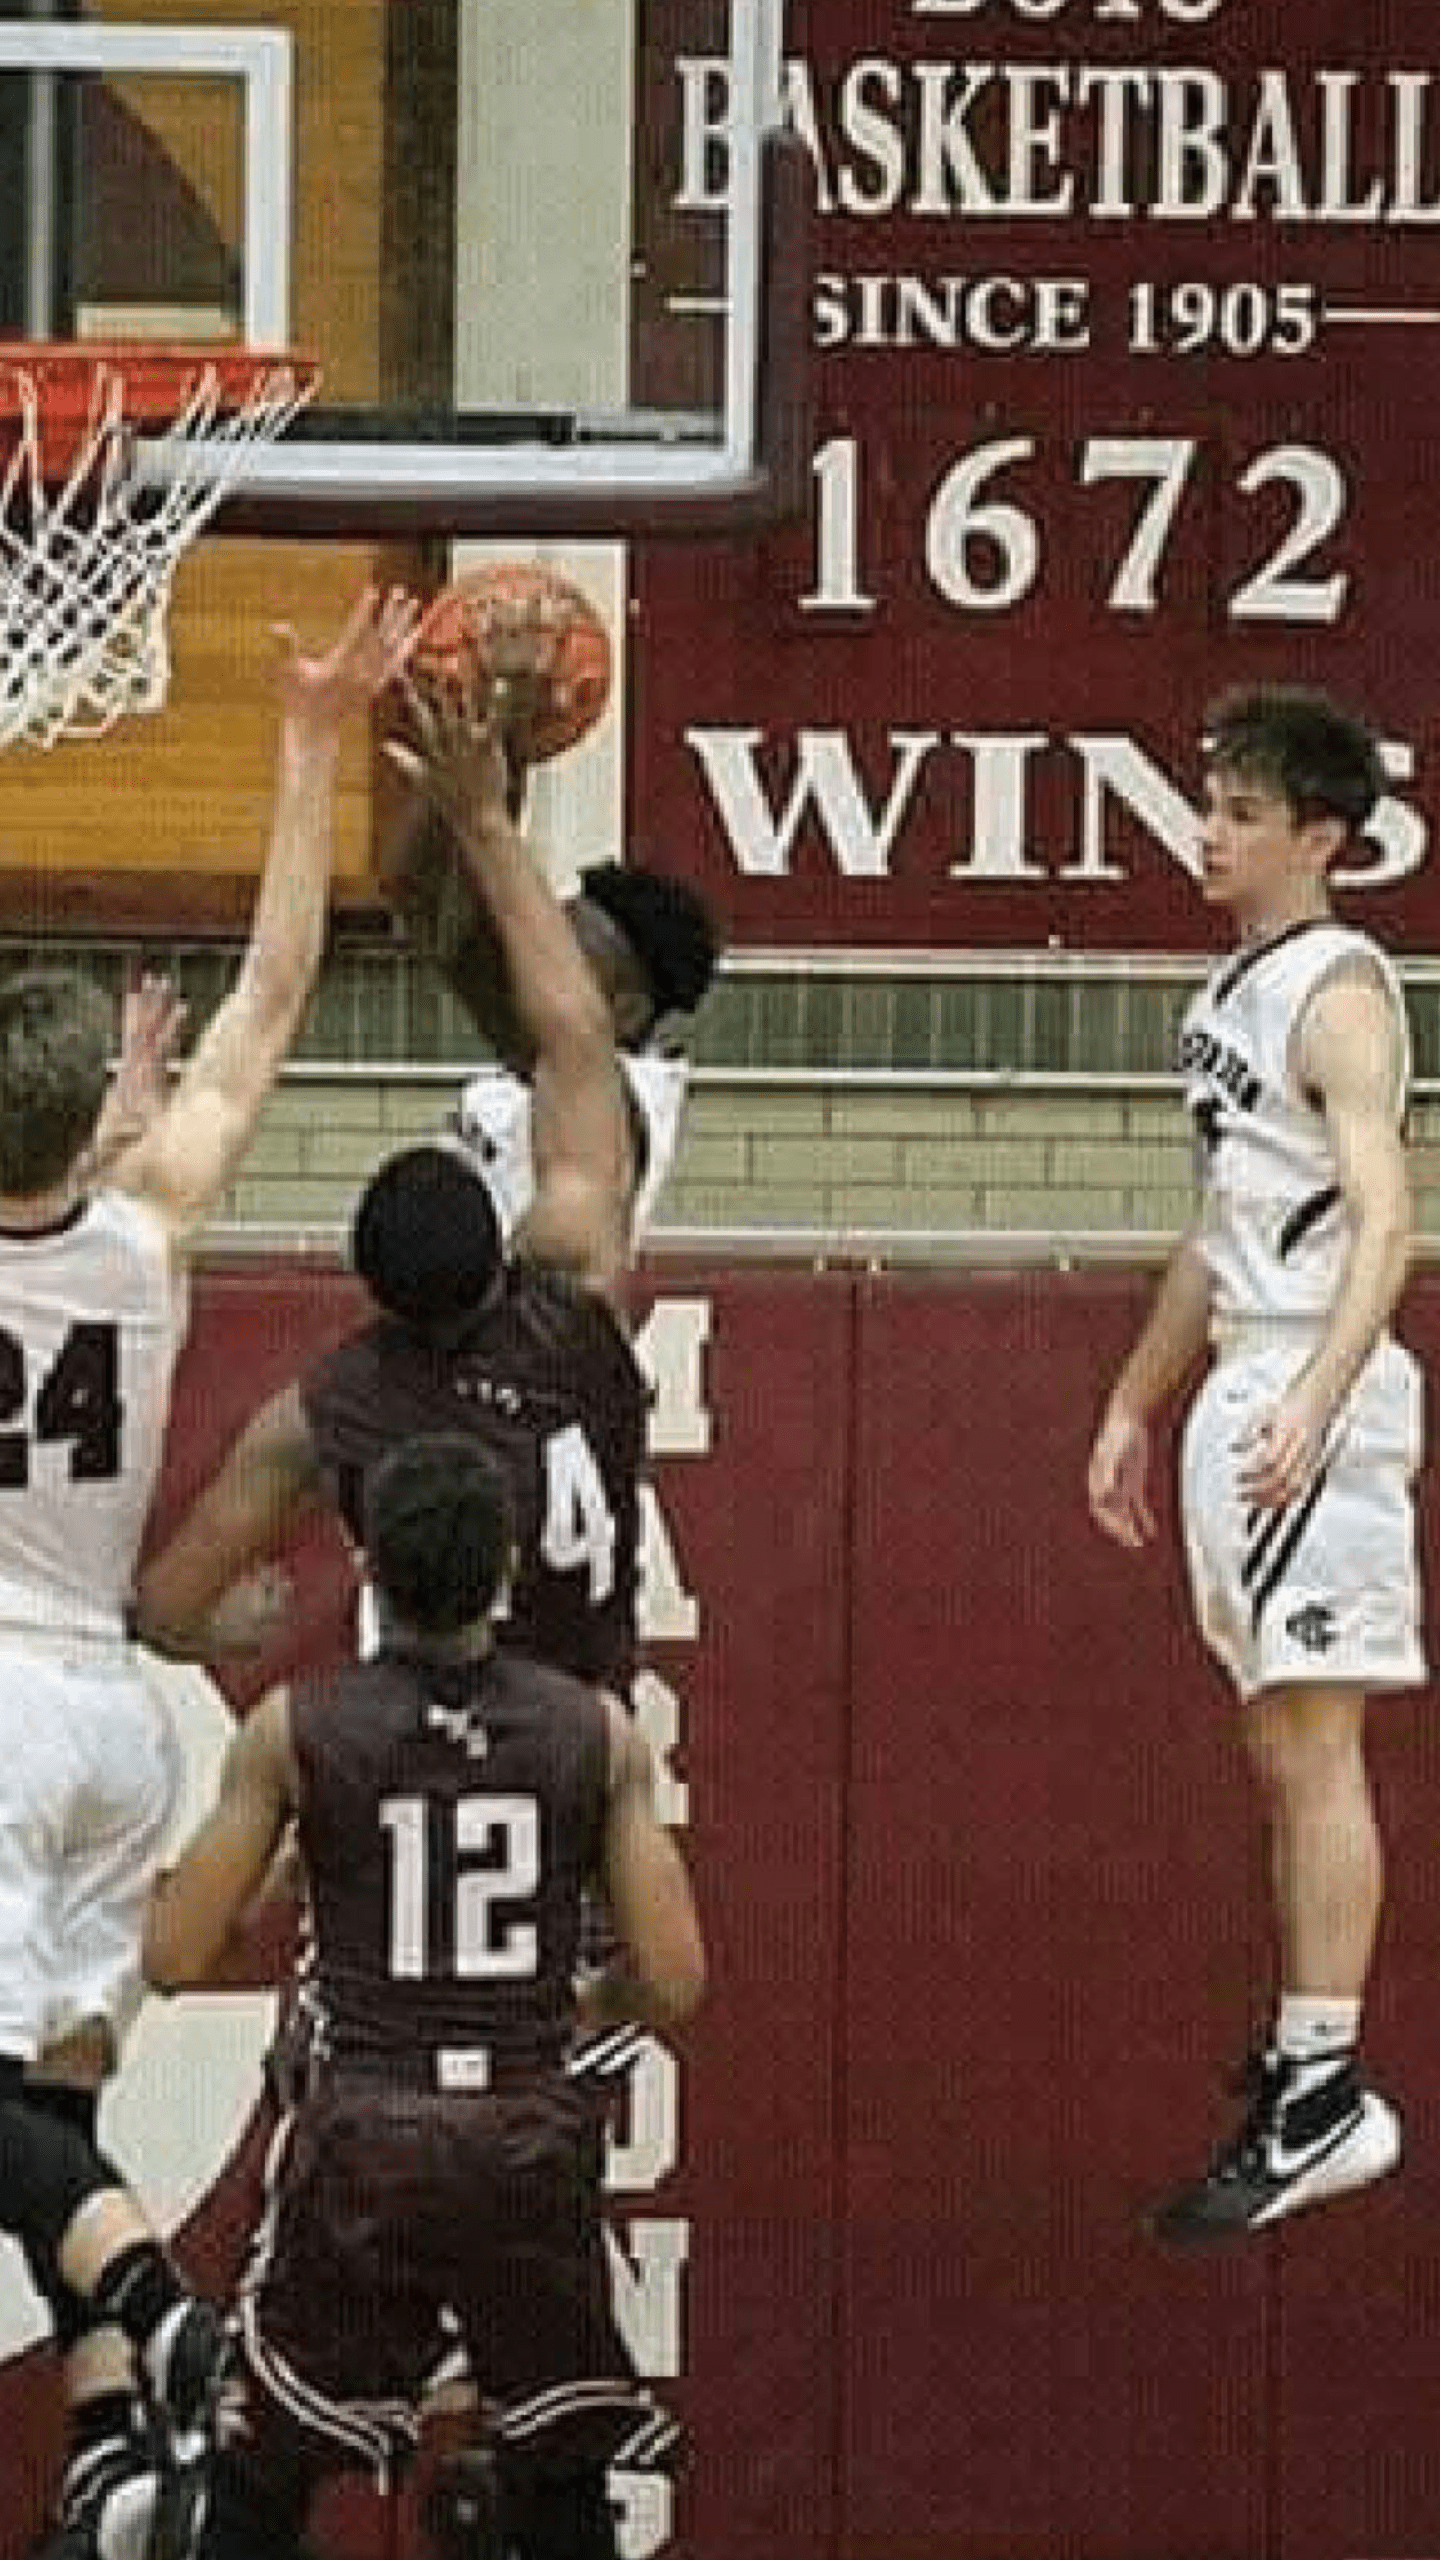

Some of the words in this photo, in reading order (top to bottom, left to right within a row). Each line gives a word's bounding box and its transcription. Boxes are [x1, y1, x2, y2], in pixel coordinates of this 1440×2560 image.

[813, 272, 1090, 349] SINCE
[1127, 282, 1317, 355] 1905
[798, 435, 1350, 622] 1672
[378, 1794, 540, 1980] 12
